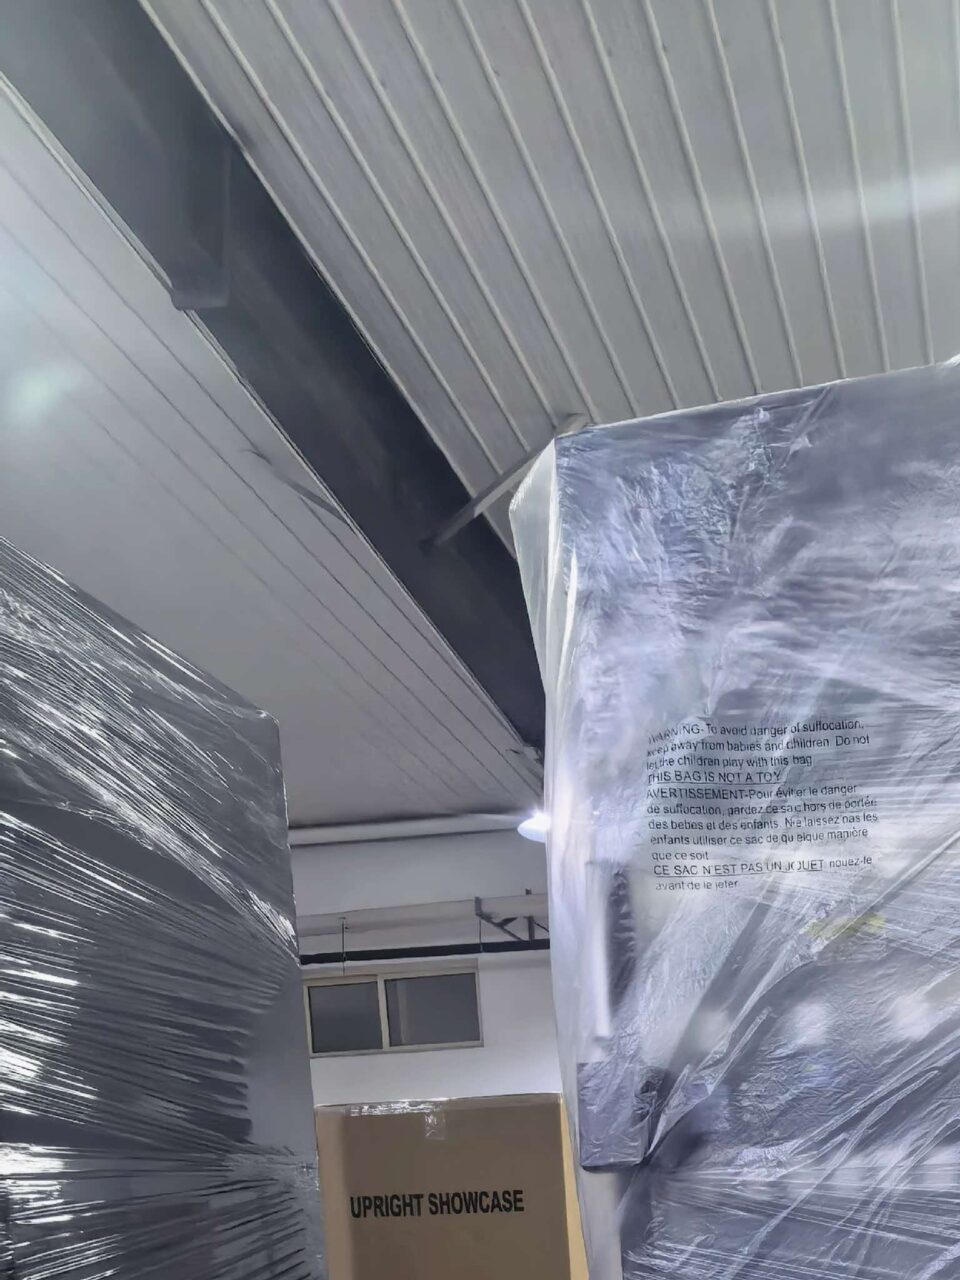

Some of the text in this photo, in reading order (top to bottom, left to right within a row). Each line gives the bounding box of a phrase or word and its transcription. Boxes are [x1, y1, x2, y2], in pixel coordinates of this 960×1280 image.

[720, 725, 747, 736] avoid
[750, 726, 787, 738] danger
[790, 722, 800, 733] of
[671, 741, 698, 753] away
[701, 740, 724, 750] from
[726, 740, 762, 752] babies
[764, 741, 784, 752] and
[835, 735, 850, 746] Do
[853, 733, 870, 745] not
[677, 755, 720, 766] children
[722, 756, 744, 770] play
[746, 756, 768, 768] with
[770, 756, 789, 766] this
[674, 770, 701, 782] BAG
[704, 771, 714, 782] IS
[718, 772, 743, 782] NOT
[746, 772, 753, 782] A
[809, 786, 818, 796] le
[821, 784, 857, 796] danger
[647, 804, 660, 814] de
[728, 804, 763, 817] gardez
[766, 804, 778, 814] ce
[804, 801, 826, 812] hors
[828, 800, 842, 810] de
[648, 820, 668, 830] des
[706, 821, 716, 830] et
[718, 820, 738, 830] des
[804, 816, 840, 827] laissez
[863, 812, 878, 822] les
[650, 834, 690, 846] enfants
[693, 835, 726, 846] utiliser
[730, 837, 742, 845] ce
[745, 836, 764, 845] sac
[766, 833, 778, 843] de
[652, 852, 672, 862] que
[674, 852, 688, 860] ce
[653, 864, 670, 876] CE
[674, 864, 698, 876] SAC
[740, 862, 763, 873] PAS
[766, 860, 782, 872] UN
[686, 881, 700, 890] de
[703, 880, 712, 890] le
[350, 1190, 525, 1218] UPRIGHT SHOWCASE
